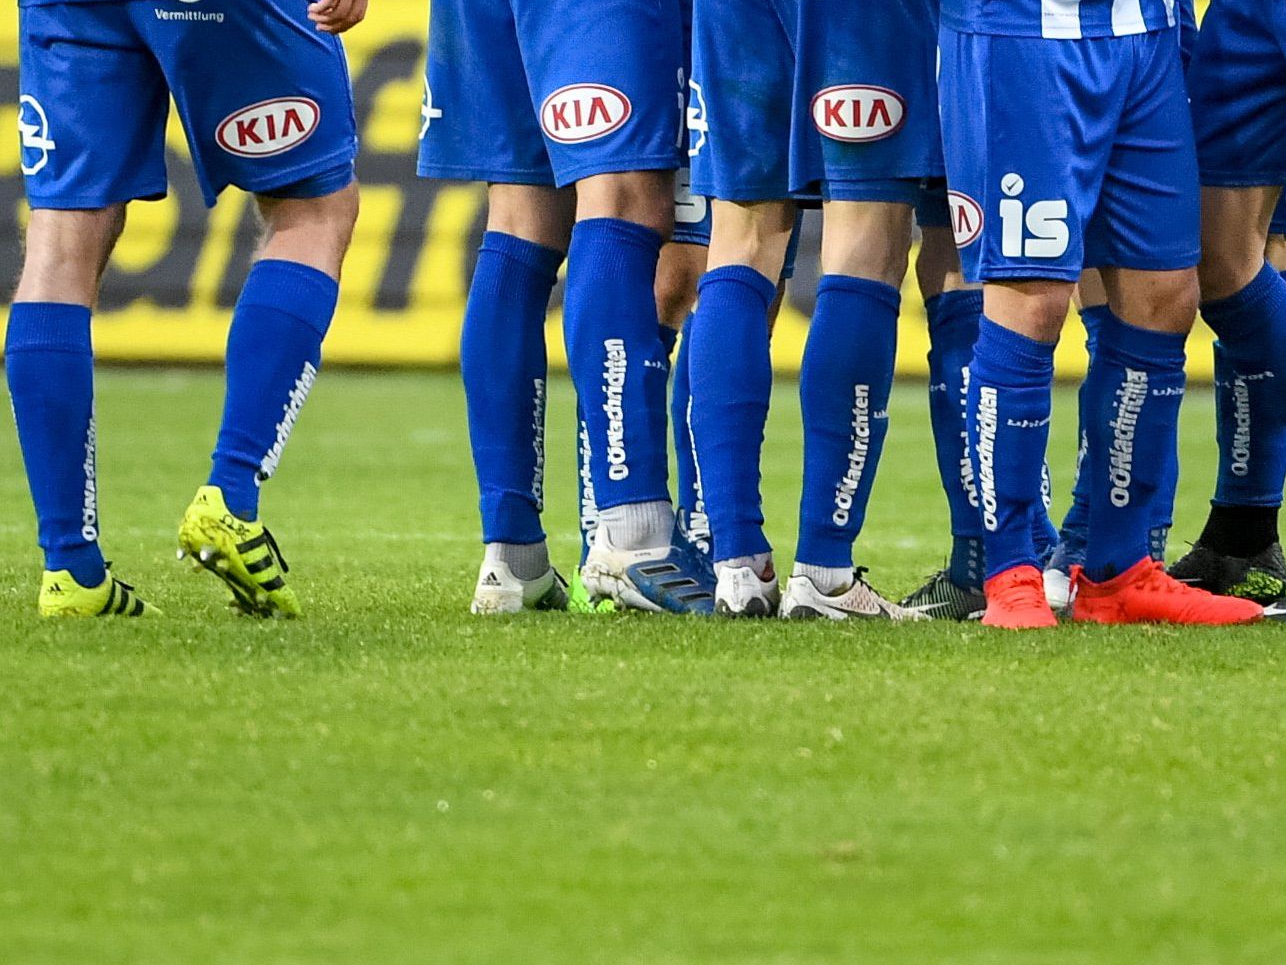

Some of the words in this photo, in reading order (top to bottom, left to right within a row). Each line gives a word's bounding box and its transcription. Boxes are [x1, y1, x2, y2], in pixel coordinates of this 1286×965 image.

[155, 8, 225, 23] Vermittlung
[237, 108, 306, 147] KIA
[552, 96, 613, 132] KIA
[823, 98, 893, 128] KIA
[999, 172, 1070, 258] is
